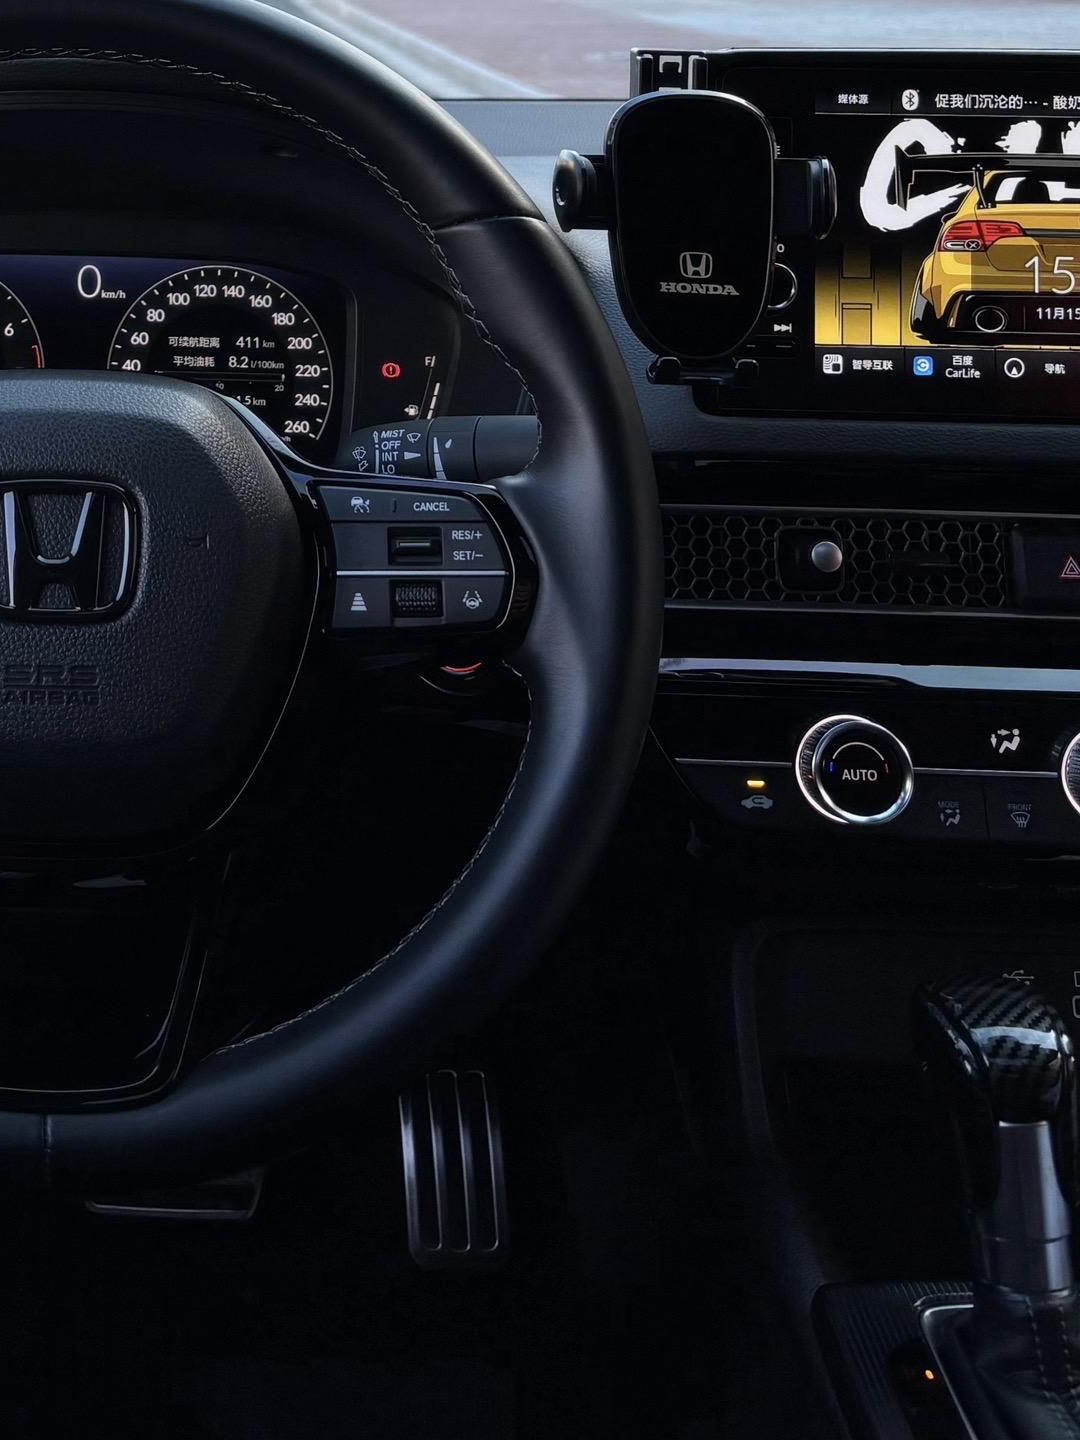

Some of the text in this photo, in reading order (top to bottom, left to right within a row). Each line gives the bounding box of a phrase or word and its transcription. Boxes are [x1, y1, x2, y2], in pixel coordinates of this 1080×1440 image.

[76, 264, 126, 300] 0 km/h
[659, 281, 740, 296] HONDA
[193, 284, 217, 297] 120
[222, 285, 245, 298] 140
[166, 292, 190, 306] 100
[249, 295, 272, 308] 160
[146, 309, 165, 323] 80
[271, 312, 295, 326] 180
[4, 322, 15, 337] 6
[130, 331, 149, 345] 60
[168, 336, 275, 349] 可续航距离 411 km
[287, 337, 313, 350] 200
[122, 360, 141, 371] 40
[172, 356, 215, 368] 平均油耗
[228, 355, 249, 369] 8.2
[951, 354, 974, 367] 百度
[295, 364, 320, 377] 220
[945, 366, 981, 379] CarLife
[1043, 362, 1066, 375] 导航
[274, 384, 284, 392] 20
[252, 397, 266, 406] km
[294, 393, 320, 407] 240
[284, 420, 310, 433] 260
[380, 429, 405, 439] MIST
[381, 440, 401, 450] OFF
[381, 451, 399, 462] INT
[381, 464, 396, 474] LO
[413, 502, 450, 511] CANCEL
[841, 768, 878, 782] AUTO
